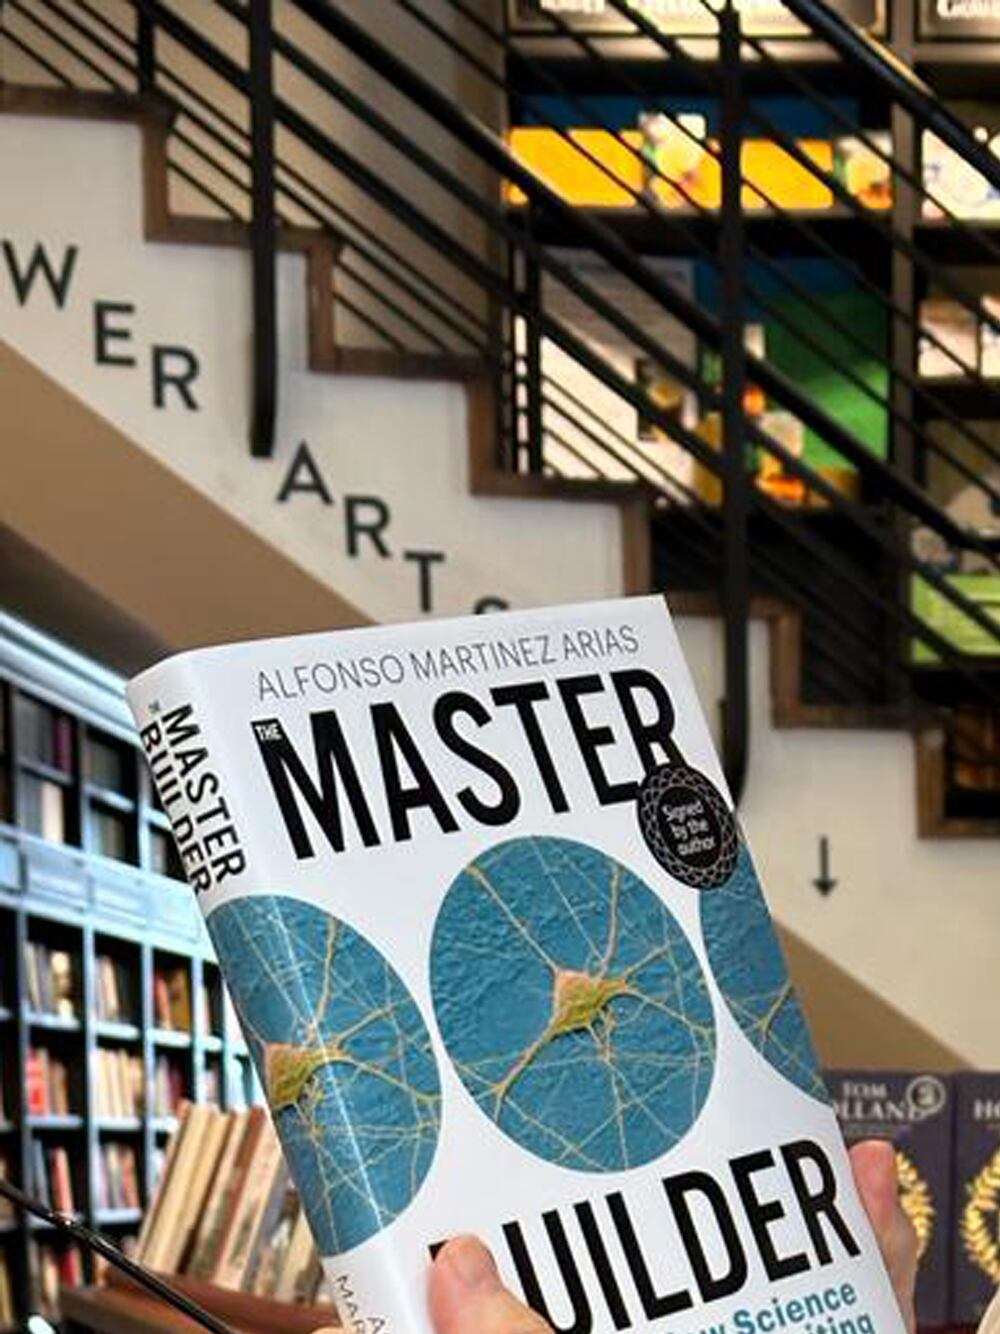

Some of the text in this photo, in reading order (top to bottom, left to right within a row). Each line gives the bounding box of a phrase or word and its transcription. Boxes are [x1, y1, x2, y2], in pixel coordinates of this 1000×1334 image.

[277, 442, 511, 616] ART
[256, 624, 641, 702] ALFONSO MARTINEZ ARIAS
[161, 703, 247, 884] MASTER
[251, 667, 689, 861] MASTER
[254, 723, 283, 743] THE
[842, 1081, 888, 1099] TOM
